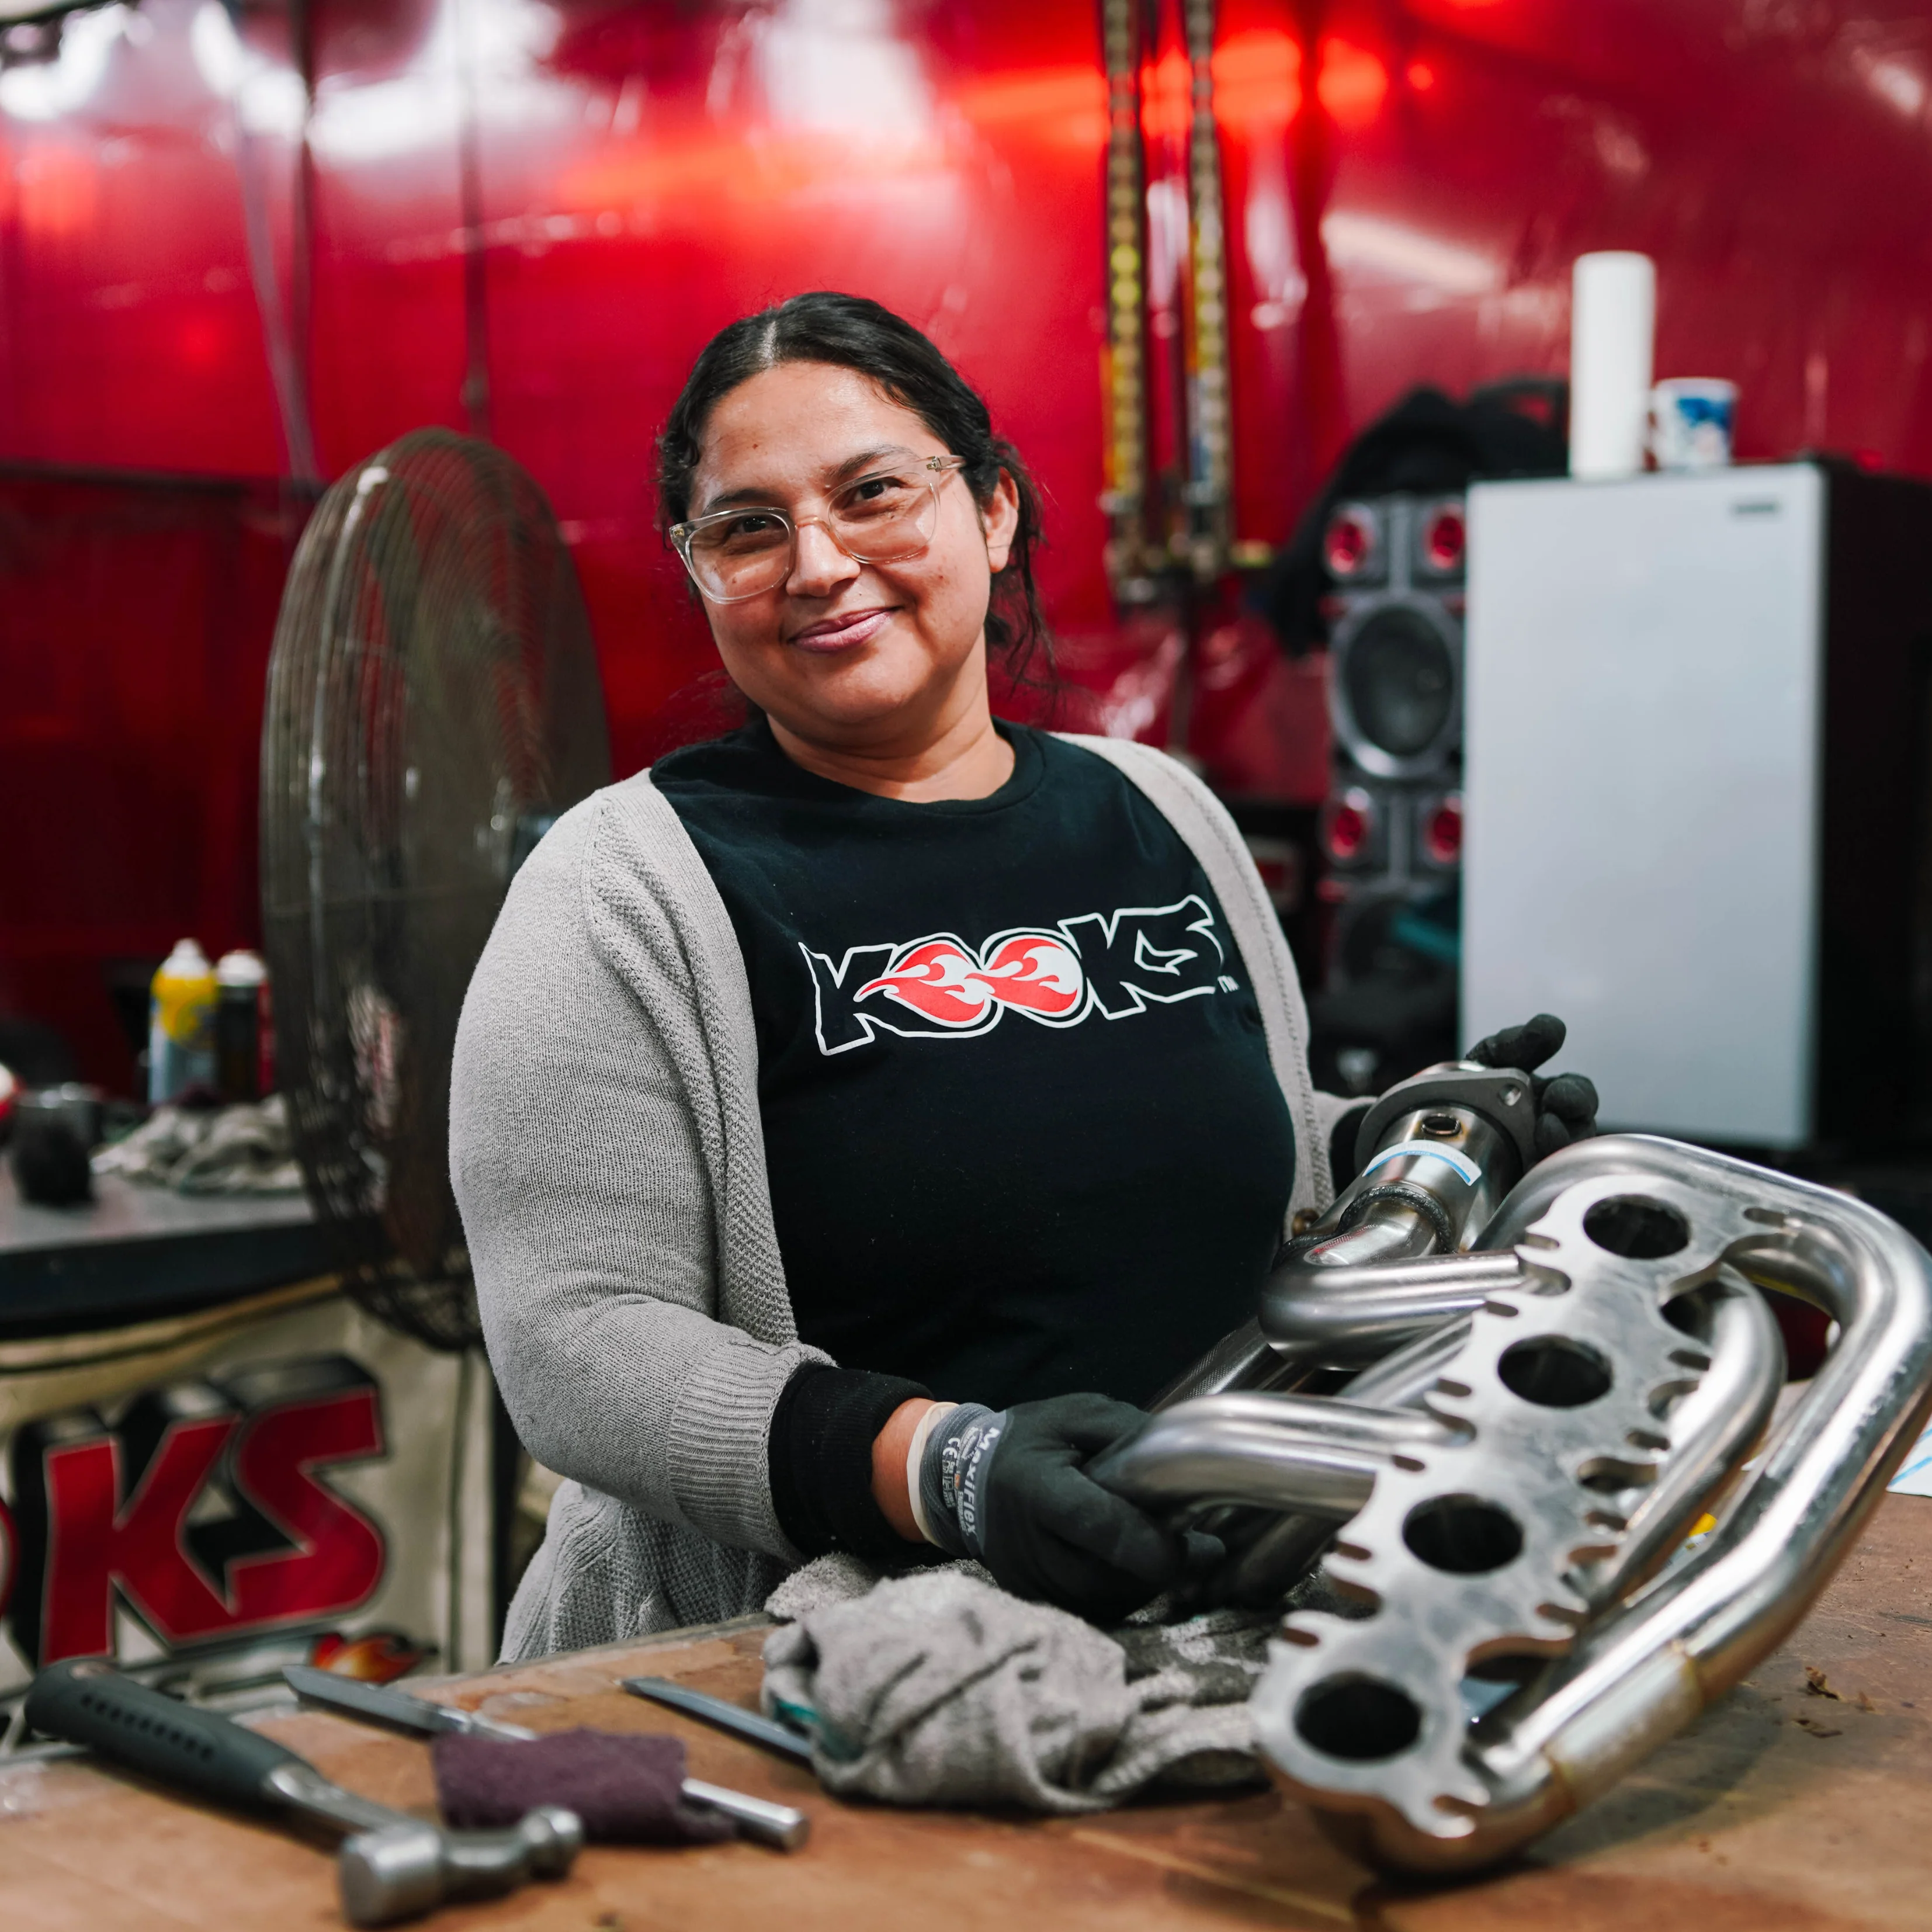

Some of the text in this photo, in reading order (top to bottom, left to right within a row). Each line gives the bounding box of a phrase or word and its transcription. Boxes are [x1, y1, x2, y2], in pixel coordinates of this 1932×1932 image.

[798, 894, 1225, 1056] KOOKS
[0, 1386, 387, 1664] KS
[963, 1427, 1000, 1535] MaxiFlex
